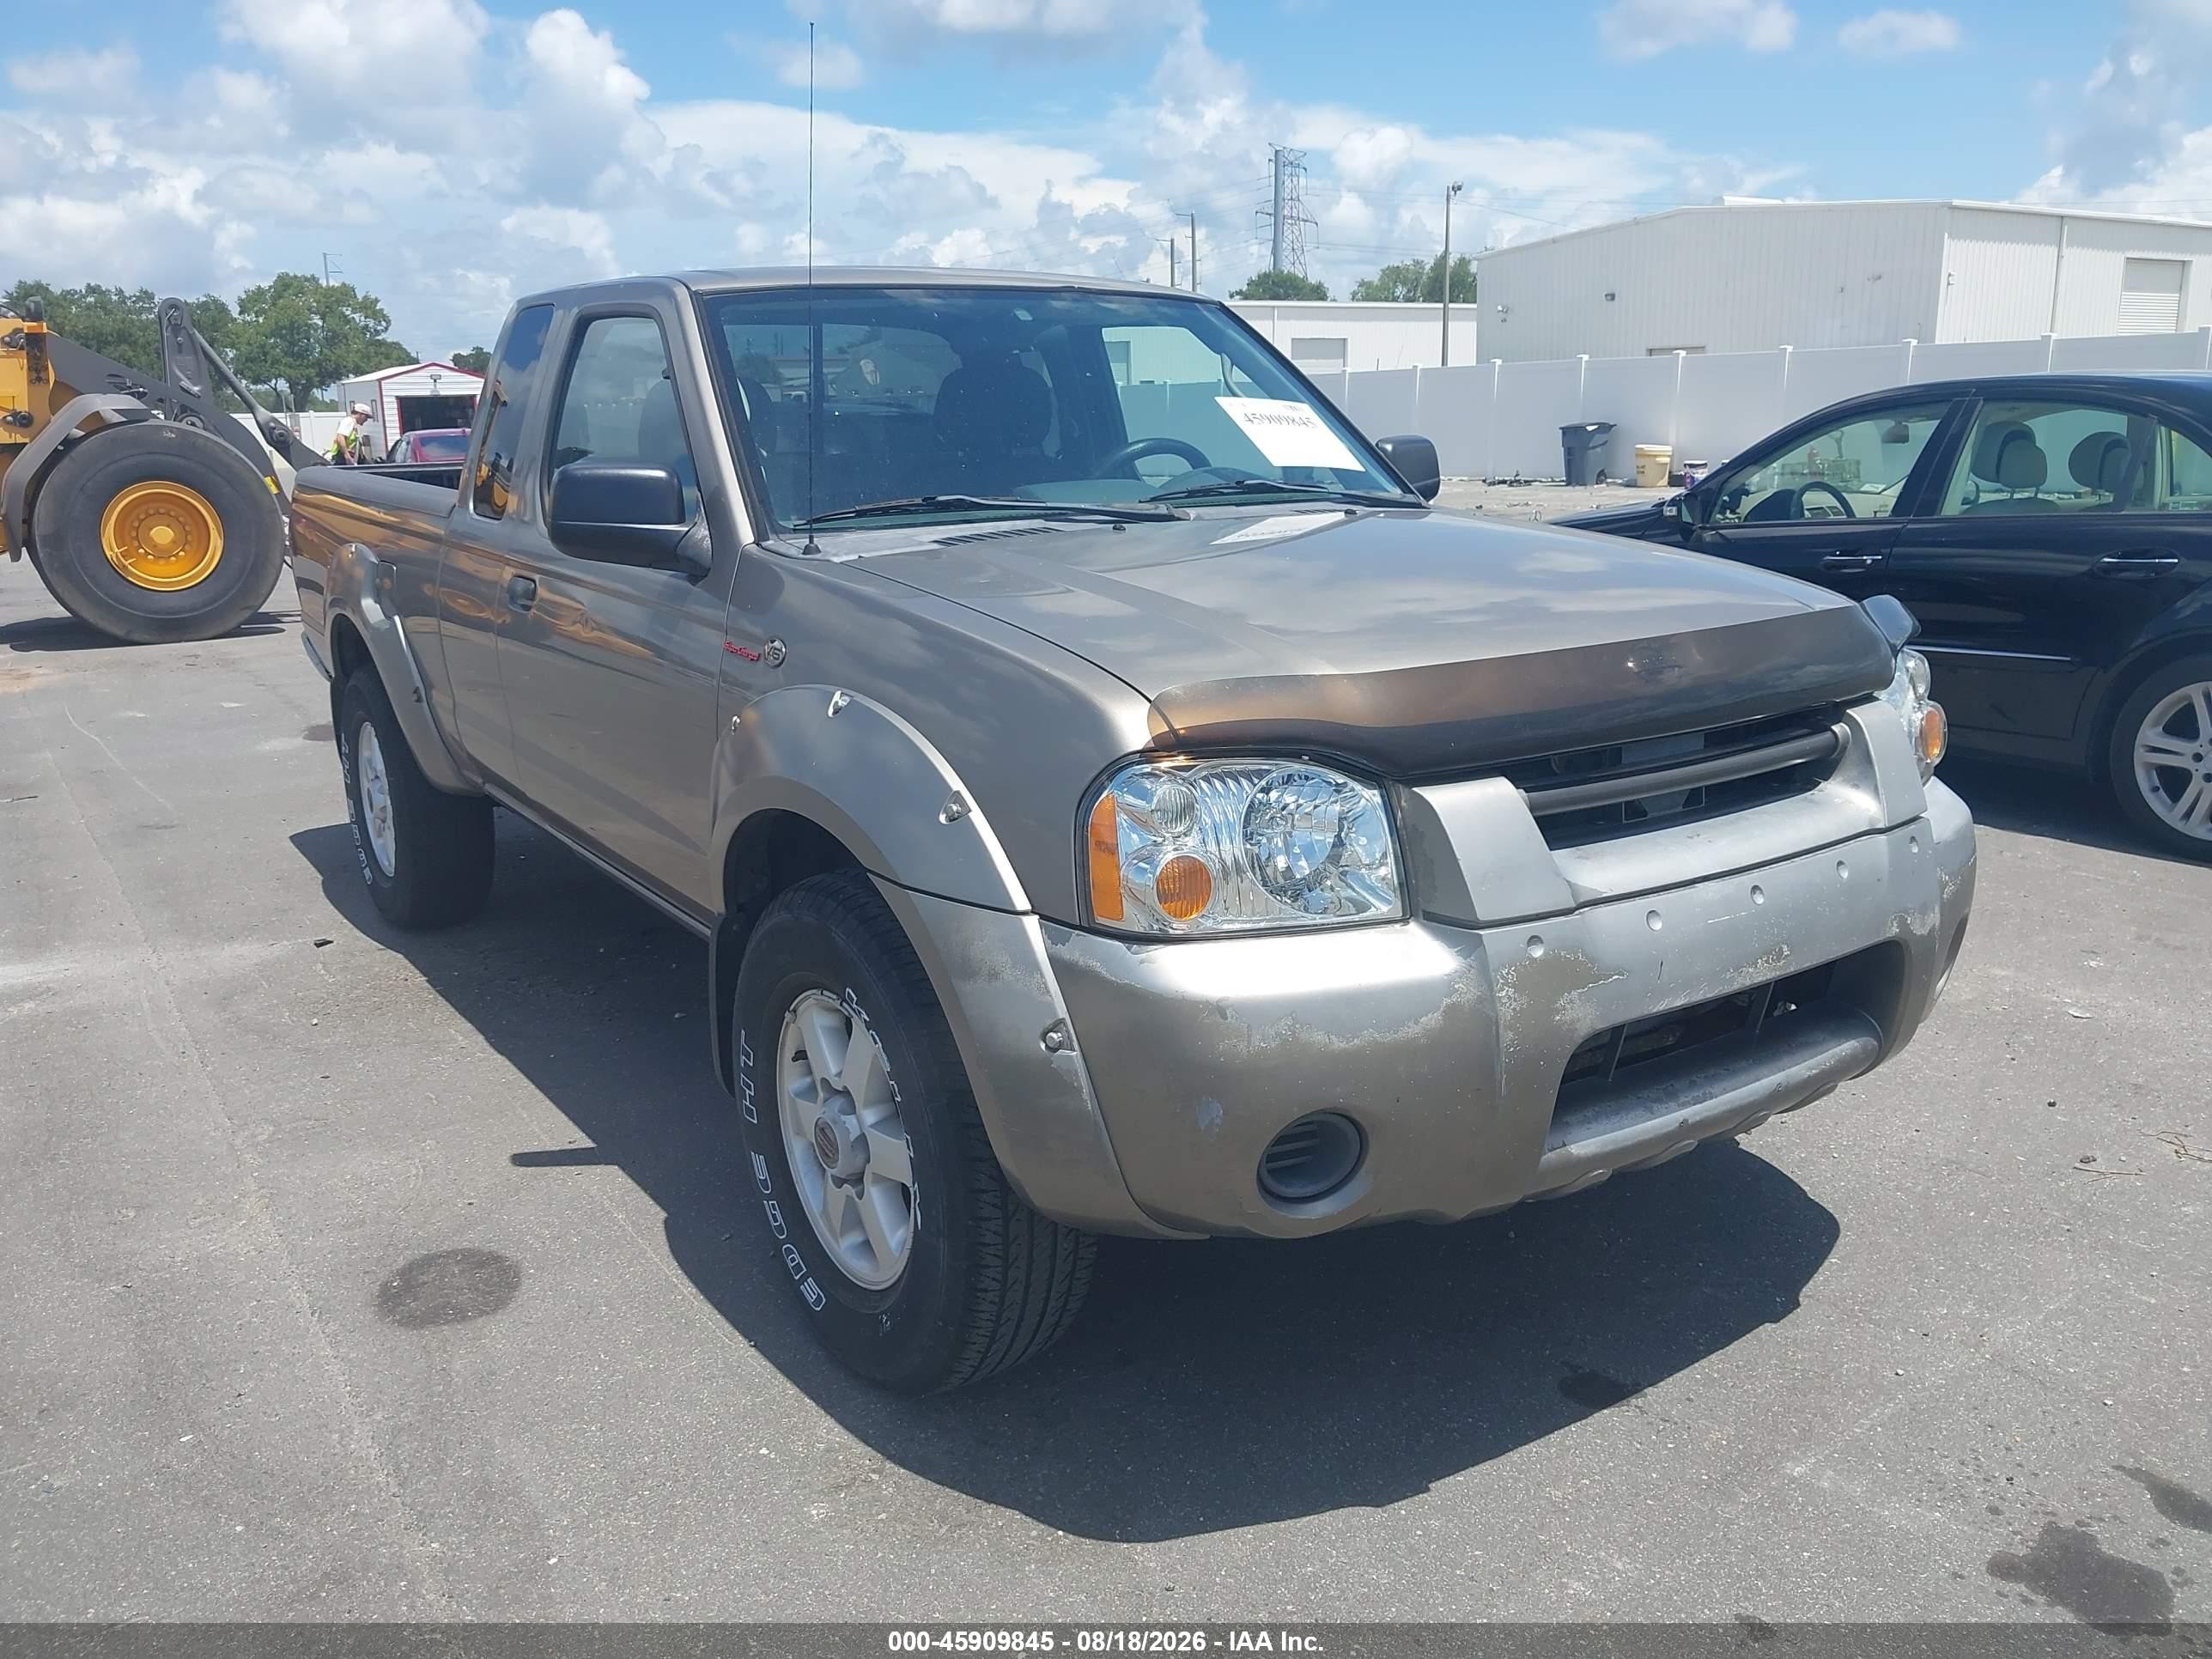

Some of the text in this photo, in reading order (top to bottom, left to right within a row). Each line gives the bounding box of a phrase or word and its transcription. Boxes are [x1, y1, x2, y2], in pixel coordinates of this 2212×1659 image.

[1243, 412, 1318, 428] 45909845
[739, 1028, 827, 1312] EDGE HT
